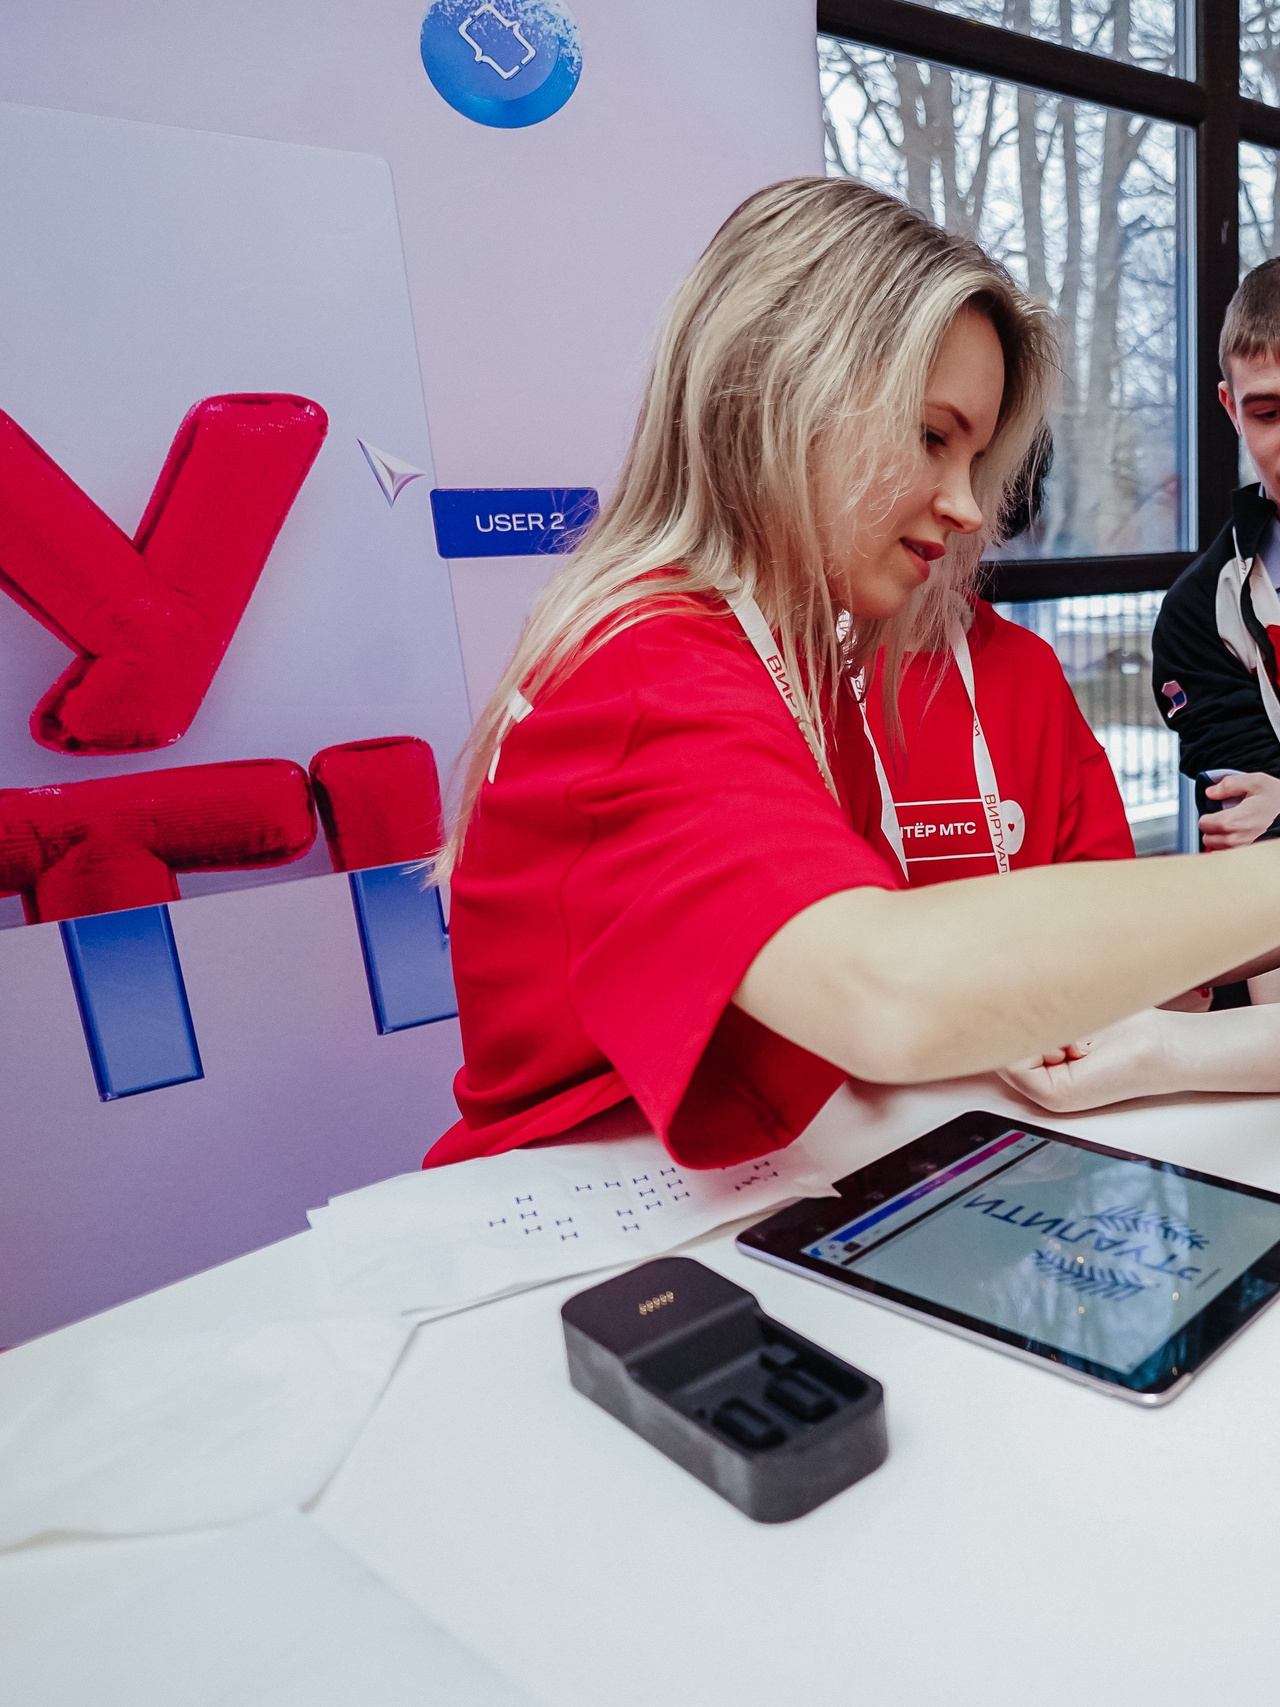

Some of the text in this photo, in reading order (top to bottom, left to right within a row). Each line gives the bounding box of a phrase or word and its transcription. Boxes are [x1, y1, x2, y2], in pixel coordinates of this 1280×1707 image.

[475, 512, 566, 533] USER 2
[939, 821, 977, 837] МТС
